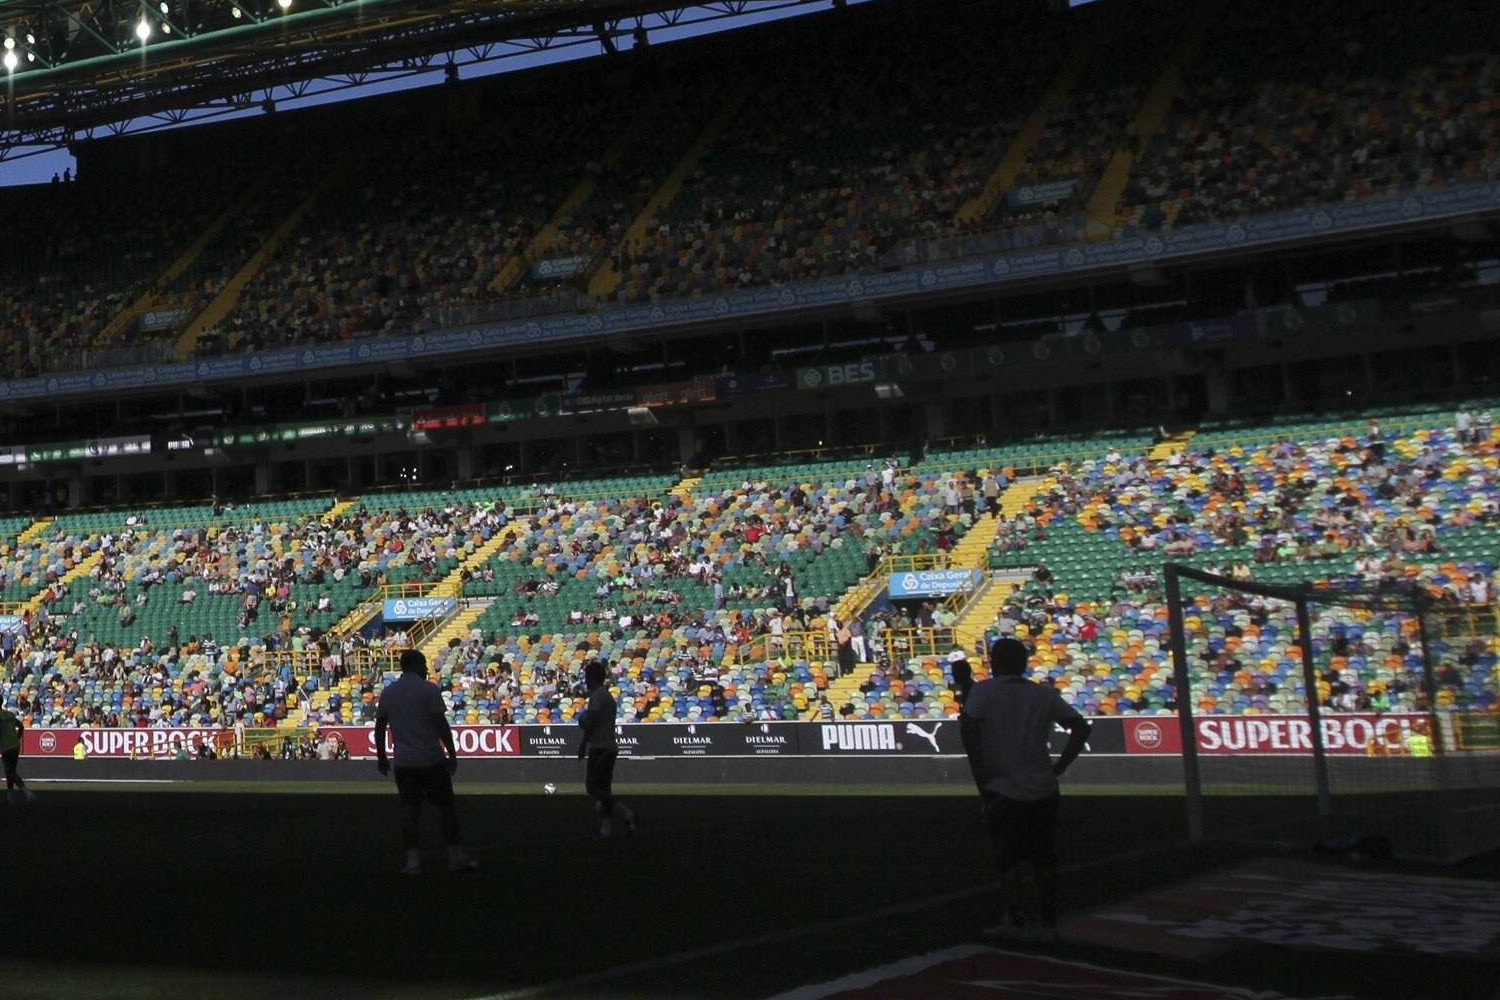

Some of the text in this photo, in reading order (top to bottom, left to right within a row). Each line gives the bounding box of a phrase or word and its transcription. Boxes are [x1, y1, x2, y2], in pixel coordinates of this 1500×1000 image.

[828, 362, 875, 384] BES
[920, 569, 972, 581] Caixa Geral
[408, 599, 427, 607] Caixa
[80, 731, 149, 754] SUPER
[673, 737, 713, 745] DIELMAR
[746, 736, 787, 744] DIELMAR
[821, 724, 896, 750] PUMA
[1199, 719, 1313, 750] SUPER
